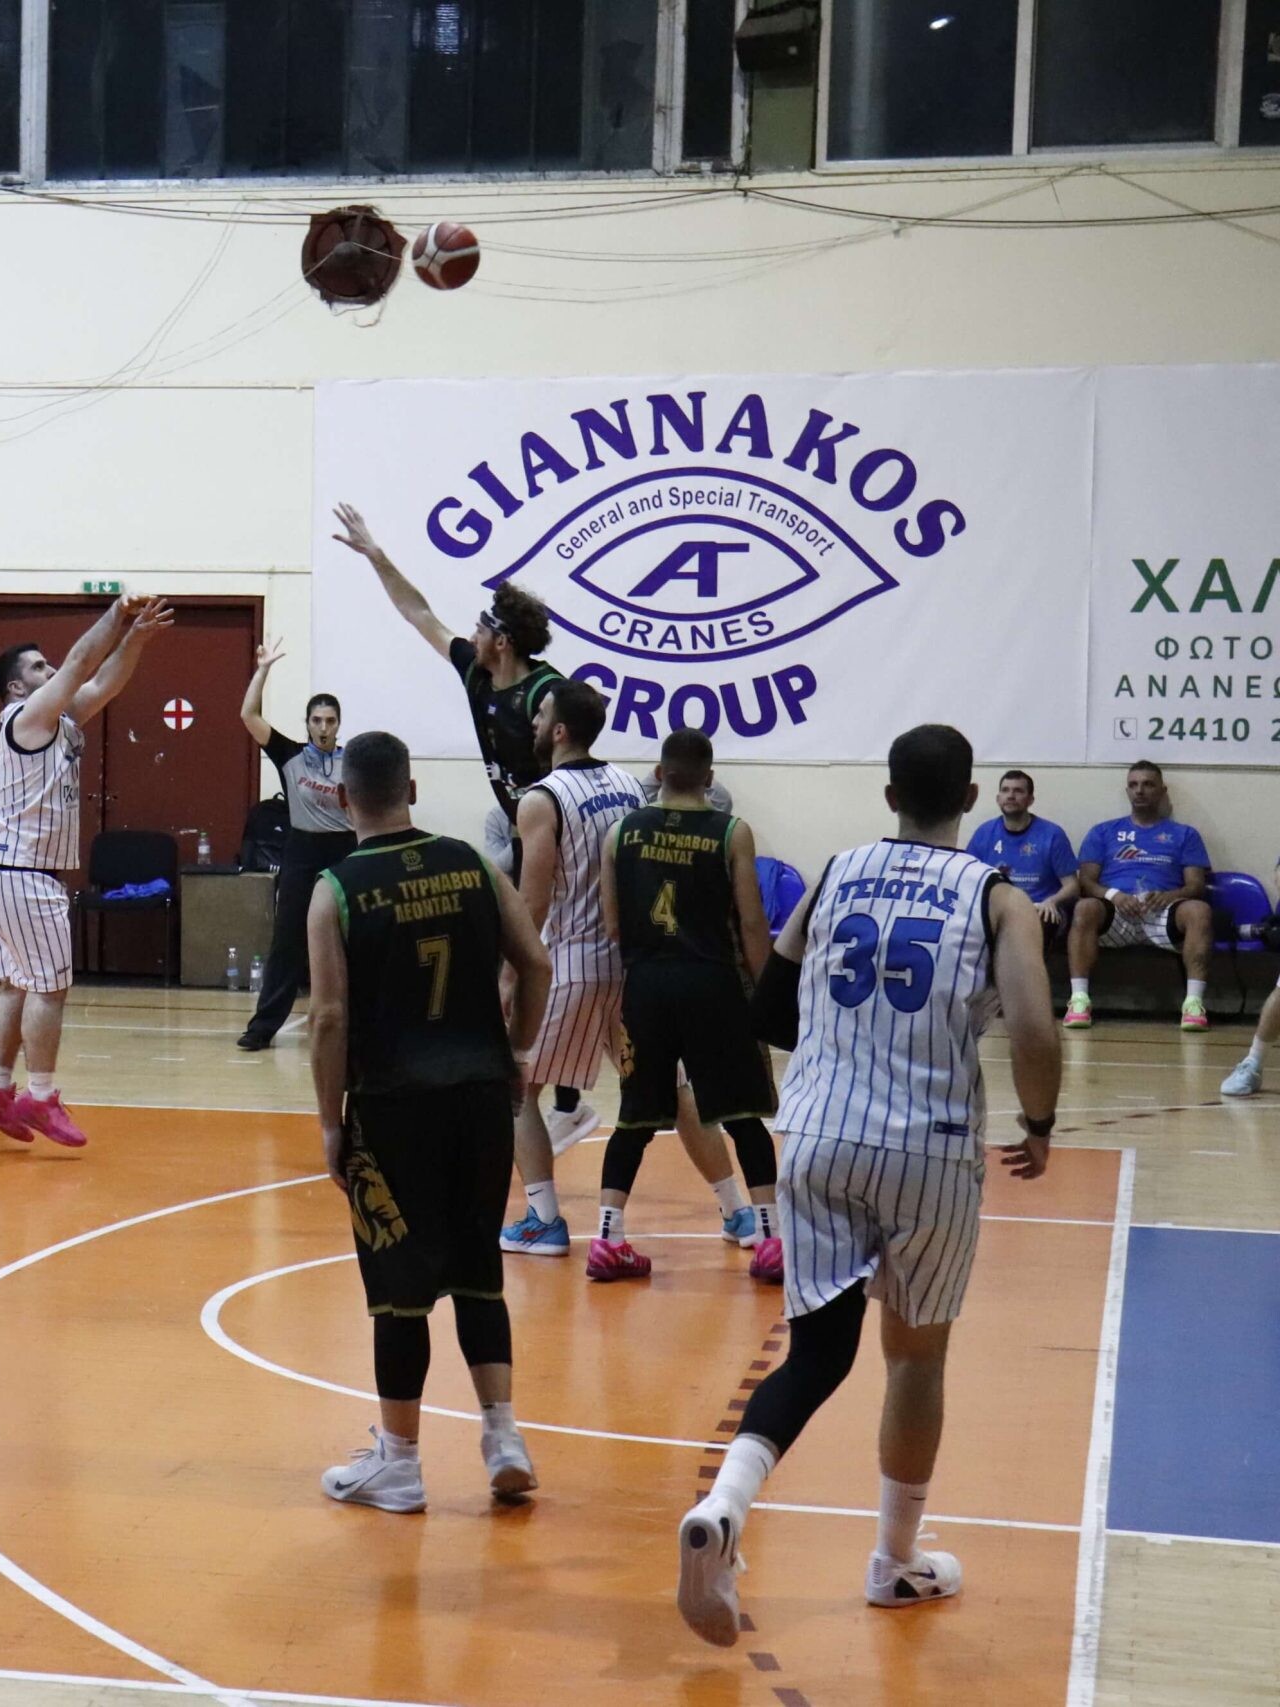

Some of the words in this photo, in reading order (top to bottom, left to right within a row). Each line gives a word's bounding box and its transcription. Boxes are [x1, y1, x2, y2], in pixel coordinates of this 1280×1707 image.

[426, 391, 967, 559] GIANNAKOS
[556, 503, 623, 559] General
[629, 490, 663, 516] and
[669, 487, 742, 509] Special
[749, 492, 836, 557] Transport
[599, 611, 774, 650] CRANES
[1148, 717, 1250, 742] 24410
[653, 831, 719, 853] ΤΥΡΝΑΒΟΥ
[398, 869, 483, 900] ΤΥΡΝΑΒΟΥ
[650, 879, 678, 936] 4
[837, 878, 960, 915] ΤΣΙΩΤΑΣ
[416, 934, 452, 1021] 7
[829, 912, 944, 1014] 35
